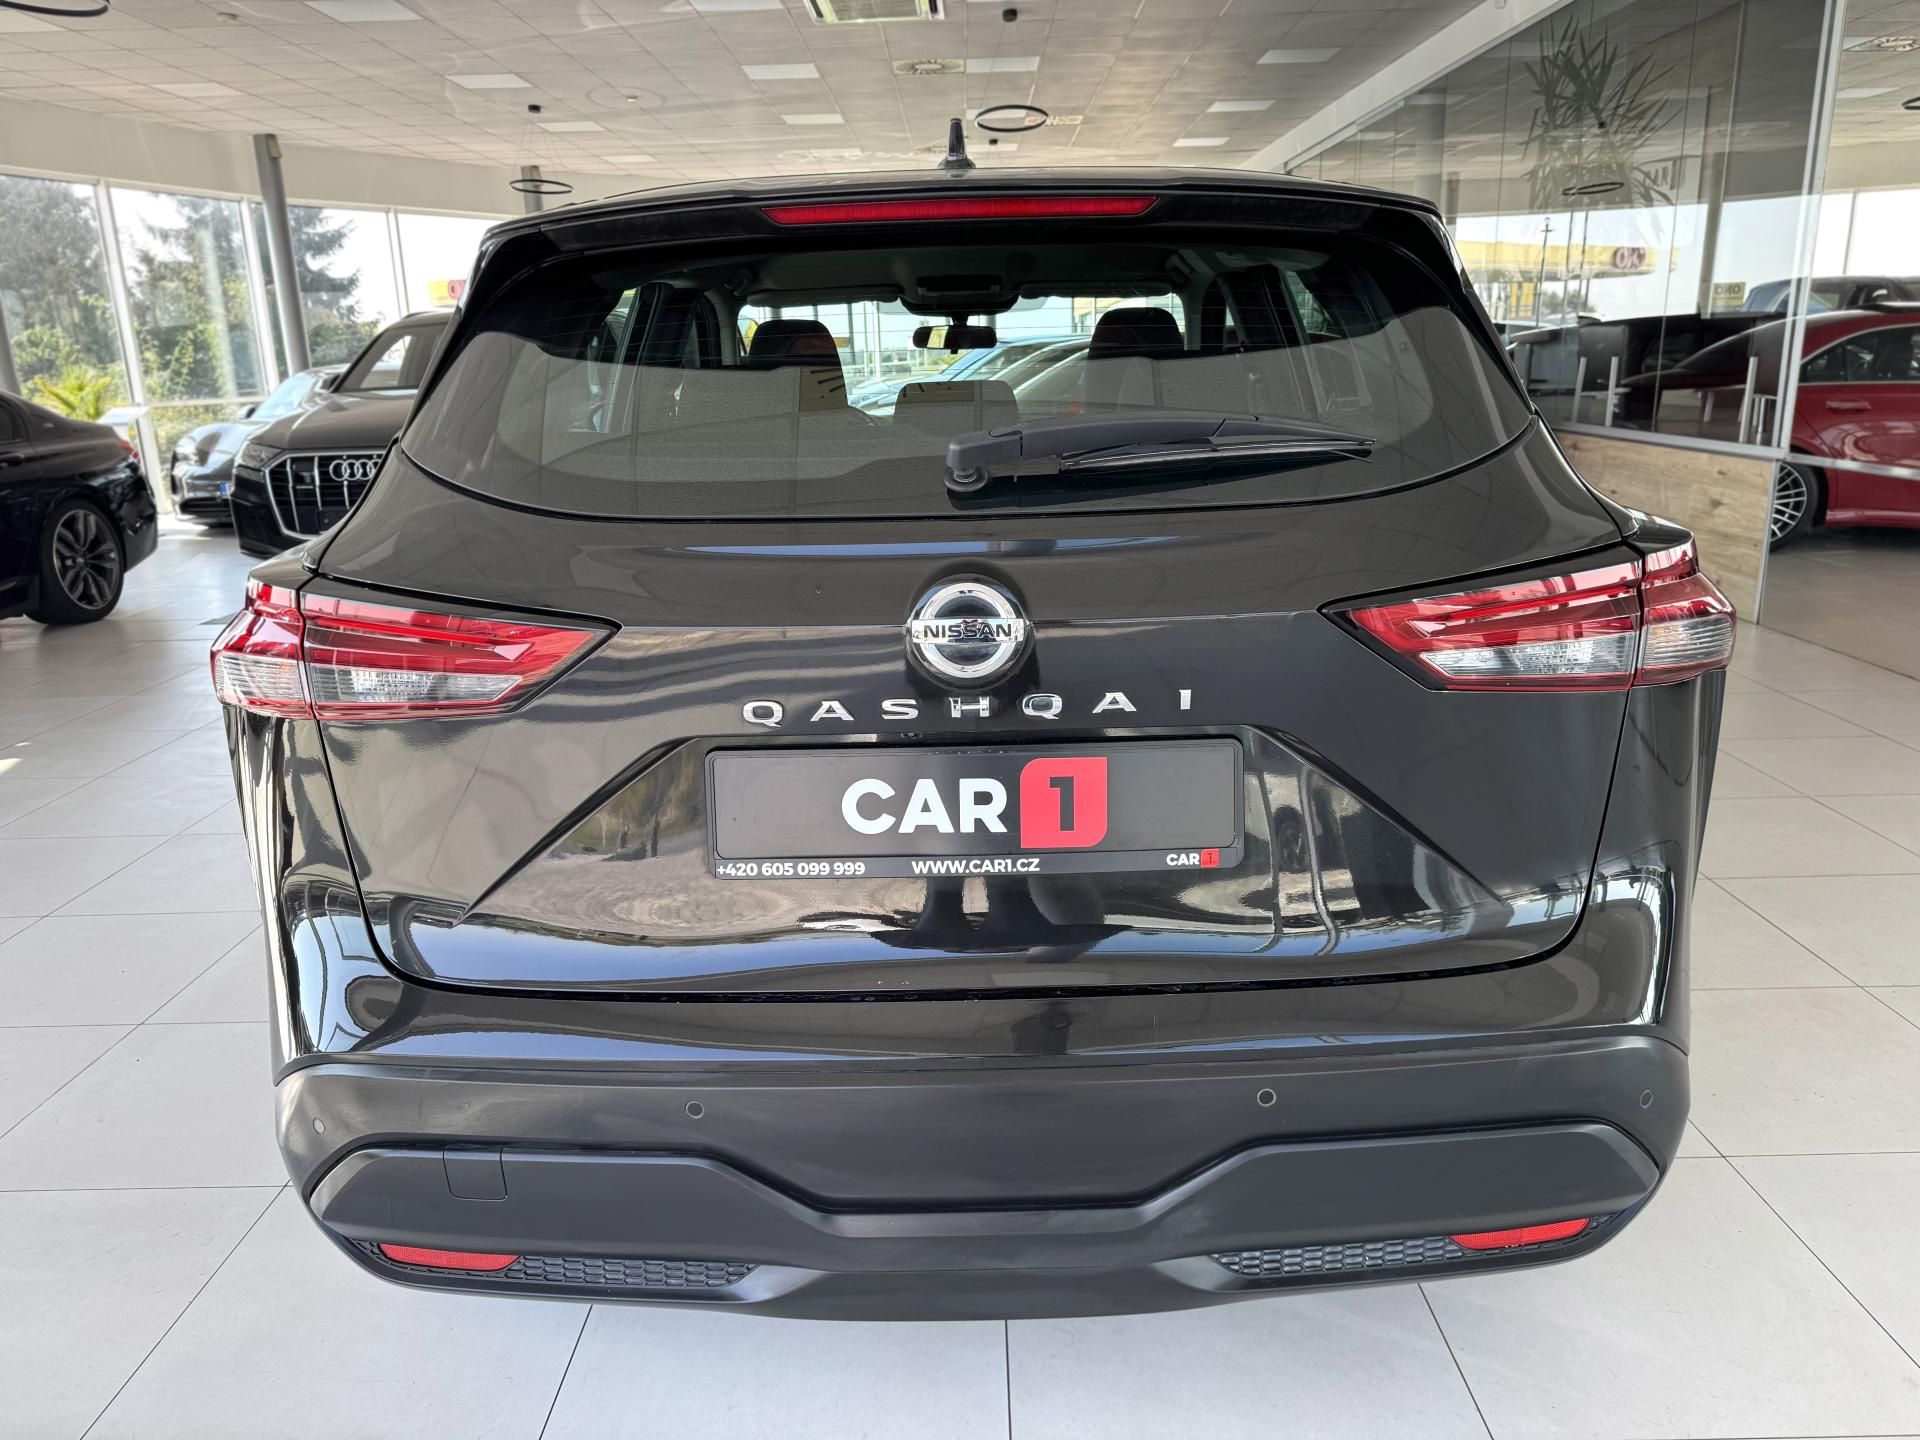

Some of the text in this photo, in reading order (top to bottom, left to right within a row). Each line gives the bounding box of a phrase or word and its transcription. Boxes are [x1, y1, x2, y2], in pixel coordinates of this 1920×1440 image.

[923, 623, 1012, 639] NISSAN
[742, 689, 1192, 728] QASHQAI
[841, 778, 1008, 835] CAR
[912, 857, 1041, 874] WWW.CAR1.CZ
[1166, 853, 1200, 866] CAR
[717, 861, 866, 877] +420 605 099 999
